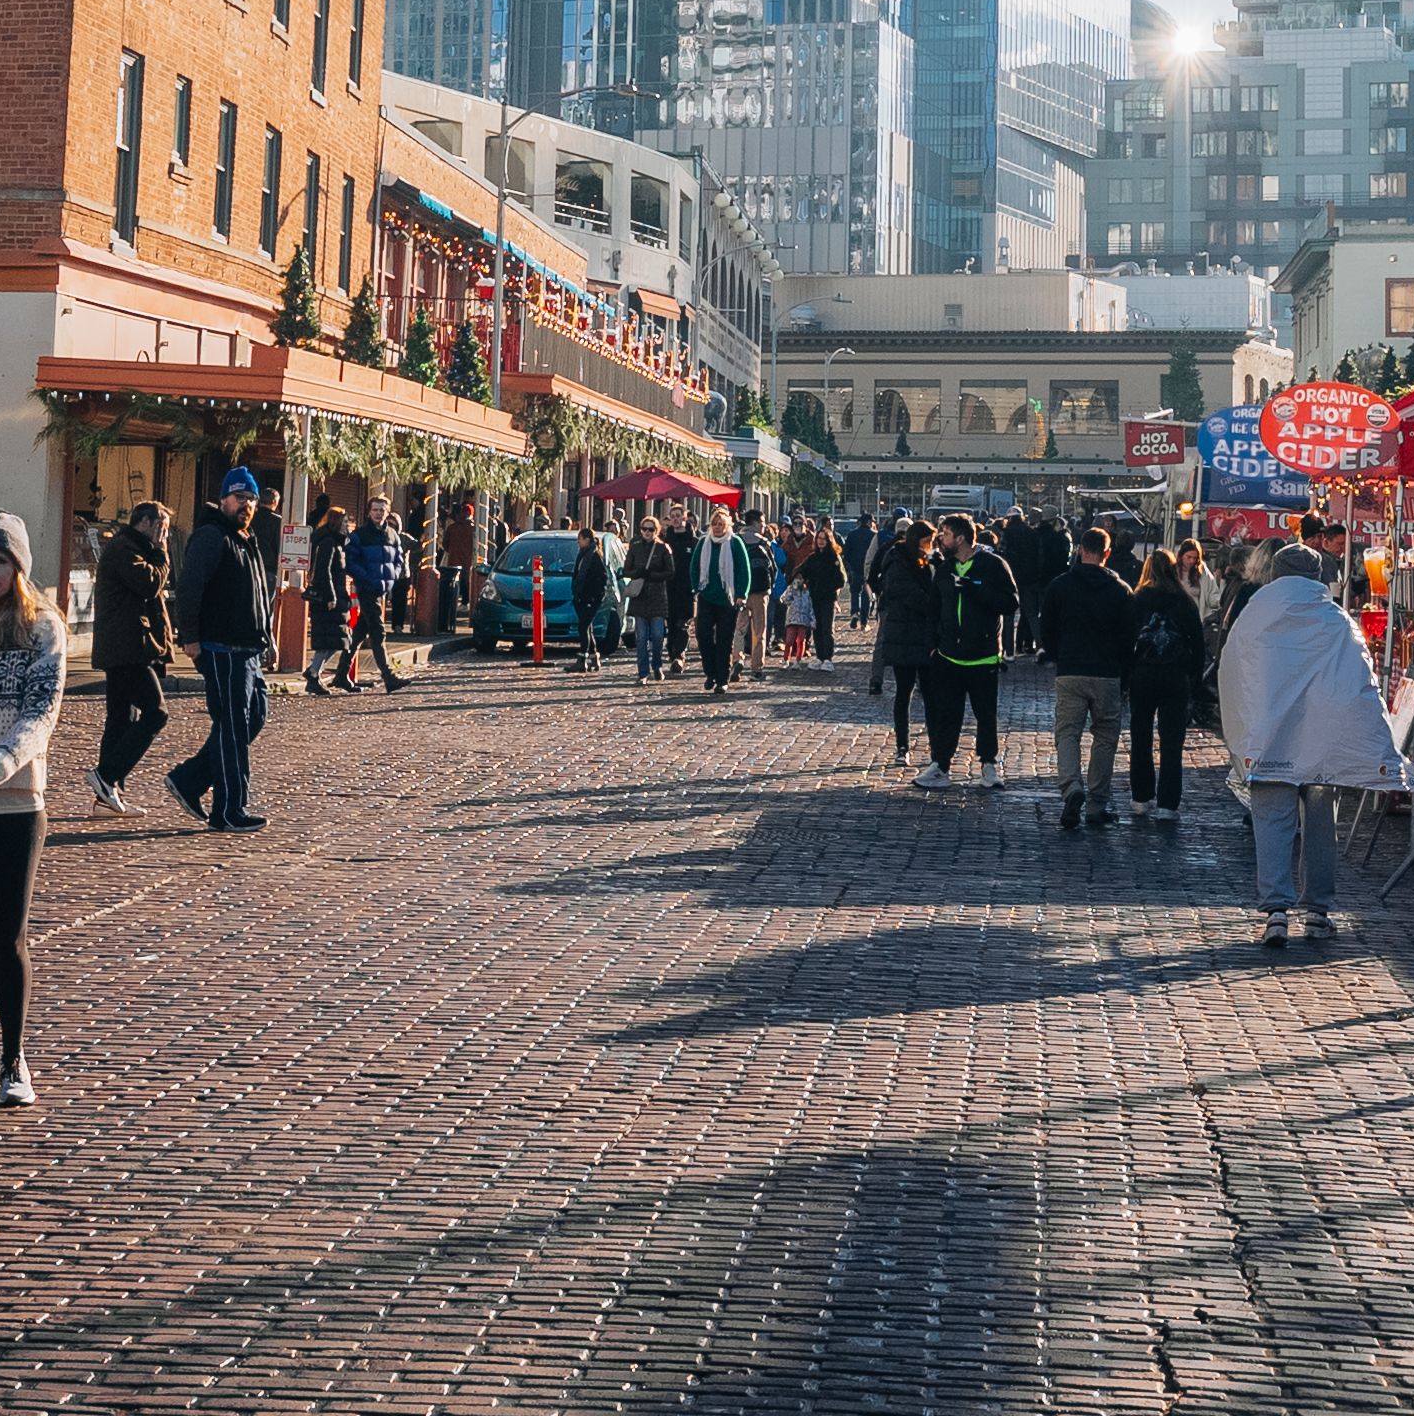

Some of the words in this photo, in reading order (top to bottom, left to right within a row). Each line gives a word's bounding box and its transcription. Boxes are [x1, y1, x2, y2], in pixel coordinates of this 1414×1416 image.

[1294, 388, 1370, 407] ORGANIC
[1232, 408, 1262, 418] ORGA
[1311, 405, 1352, 423] HOT
[1232, 423, 1248, 434] ICE
[1278, 422, 1382, 444] APPLE
[1141, 432, 1169, 444] HOT
[1132, 443, 1179, 456] COCOA
[1213, 439, 1275, 458] APP
[1277, 442, 1381, 471] CIDER
